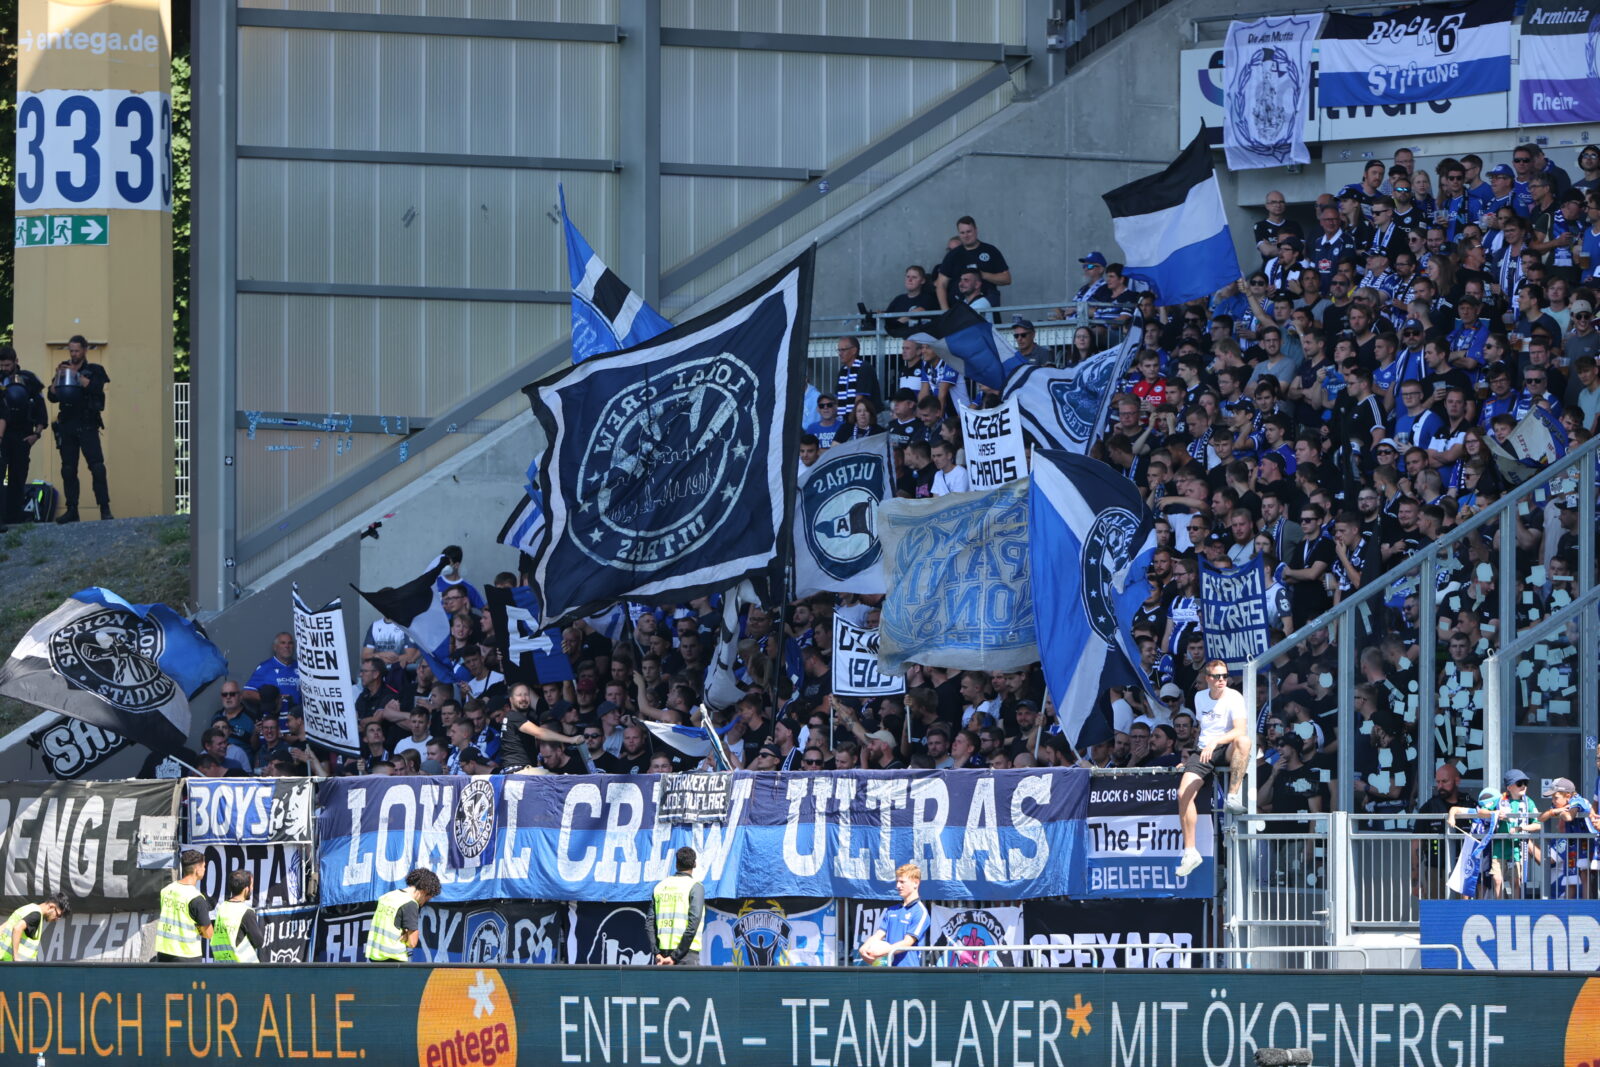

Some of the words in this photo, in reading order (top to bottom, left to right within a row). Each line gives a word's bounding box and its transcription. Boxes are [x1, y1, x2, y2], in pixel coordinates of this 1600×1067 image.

[1529, 7, 1590, 25] Arminia
[37, 28, 159, 54] entega.de
[1434, 12, 1466, 57] 6
[1532, 92, 1579, 111] Rhein-
[964, 407, 1012, 440] LIEBE
[970, 456, 1018, 486] CHAOS
[1203, 599, 1265, 631] ULTRAS
[55, 613, 129, 669] SEKTION
[309, 631, 335, 648] WIR
[1205, 628, 1269, 659] ARMINIA
[318, 700, 346, 718] WIR
[708, 774, 728, 792] ALS
[1090, 790, 1121, 803] BLOCK
[1122, 790, 1129, 802] 6
[1136, 789, 1165, 802] SINCE
[190, 785, 272, 838] BOYS
[343, 782, 532, 885] LOKL
[782, 773, 1053, 882] ULTRAS
[1088, 822, 1130, 851] The
[1136, 821, 1186, 851] Firm
[200, 845, 290, 908] ORTA
[1091, 865, 1188, 891] BIELEFELD
[0, 991, 142, 1057] NDLICH
[165, 981, 240, 1058] FÜR
[257, 993, 366, 1059] ALLE.
[560, 995, 726, 1067] ENTEGA
[1113, 1001, 1187, 1067] MIT
[425, 1020, 511, 1067] entega
